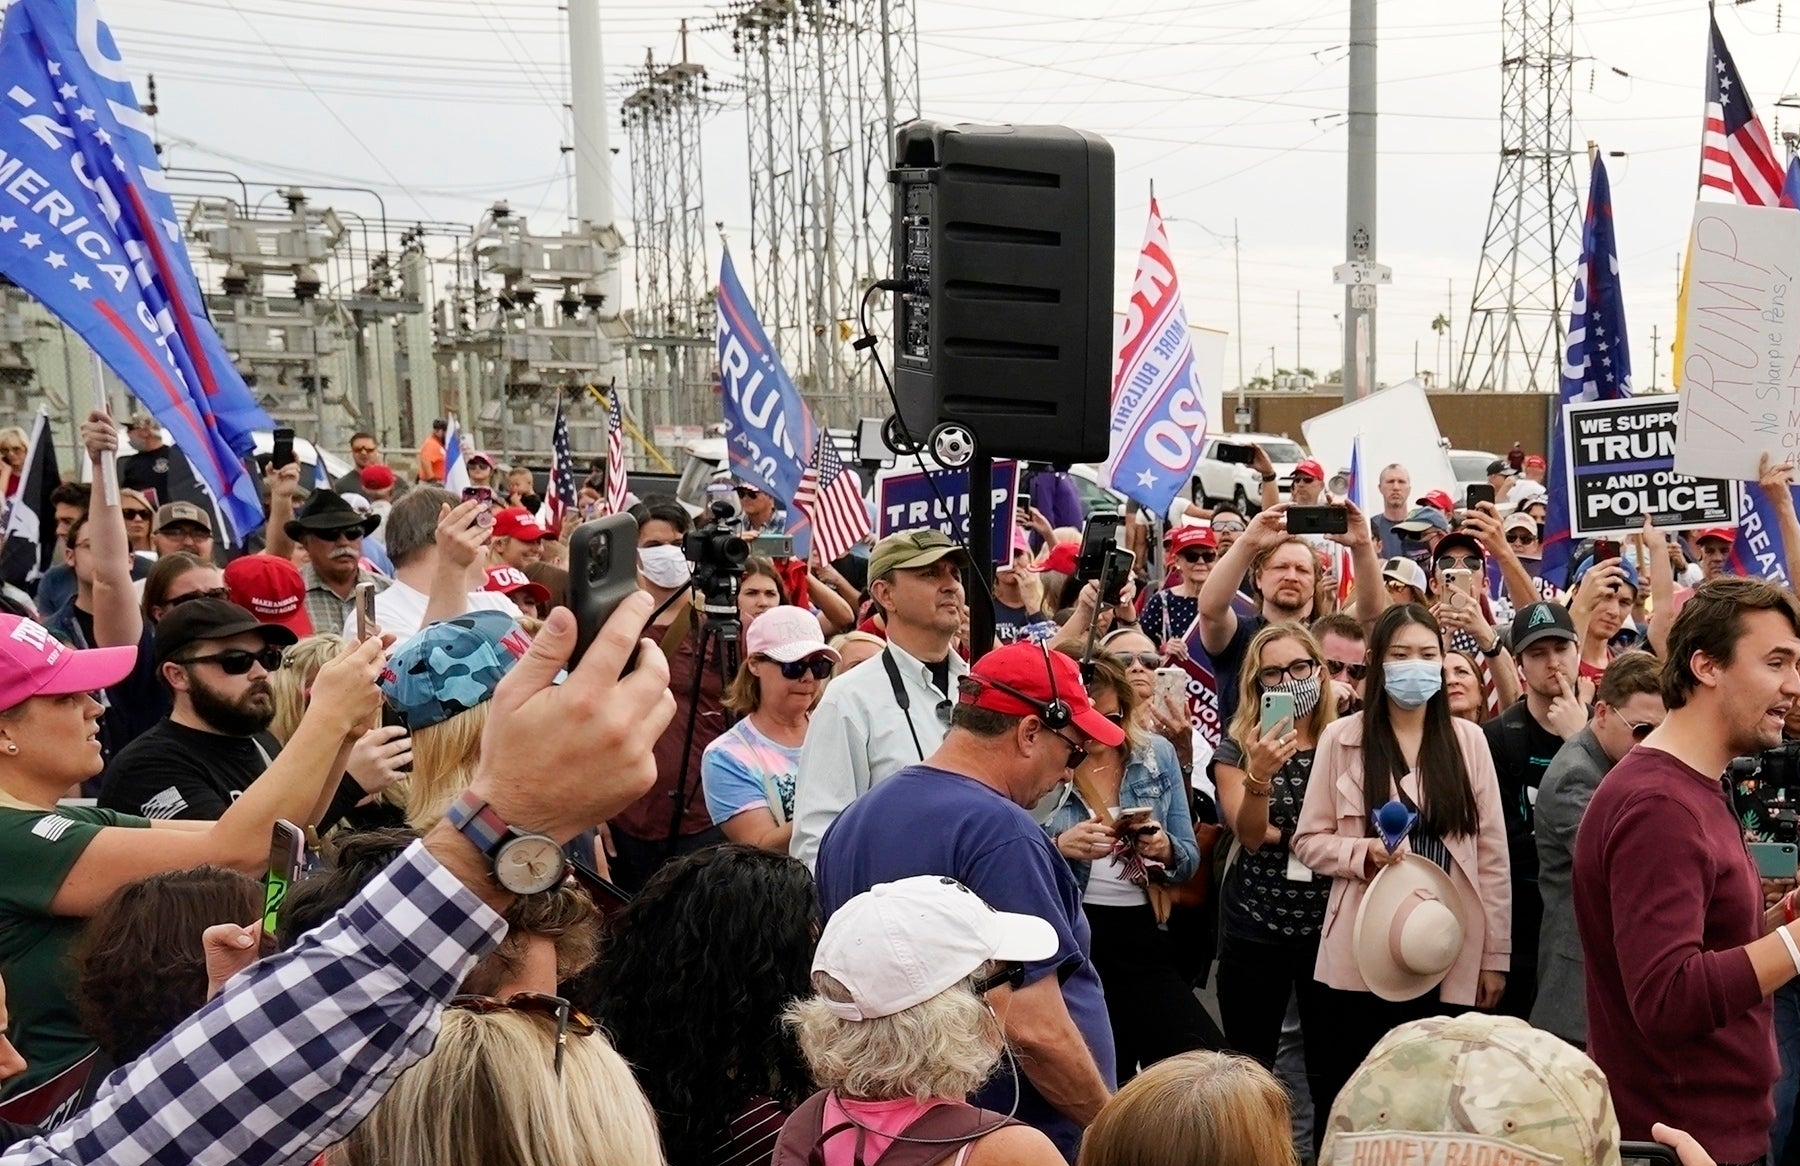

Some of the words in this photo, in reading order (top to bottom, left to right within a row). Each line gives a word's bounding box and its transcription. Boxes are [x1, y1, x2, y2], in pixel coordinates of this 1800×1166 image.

[0, 149, 130, 293] MERICA
[1685, 216, 1771, 443] TRUMP
[1755, 333, 1786, 401] Sharpie
[1580, 416, 1612, 434] WE
[1751, 413, 1779, 435] No
[1581, 431, 1677, 462] TRUM
[1606, 475, 1648, 490] AND
[1587, 485, 1719, 518] POLICE
